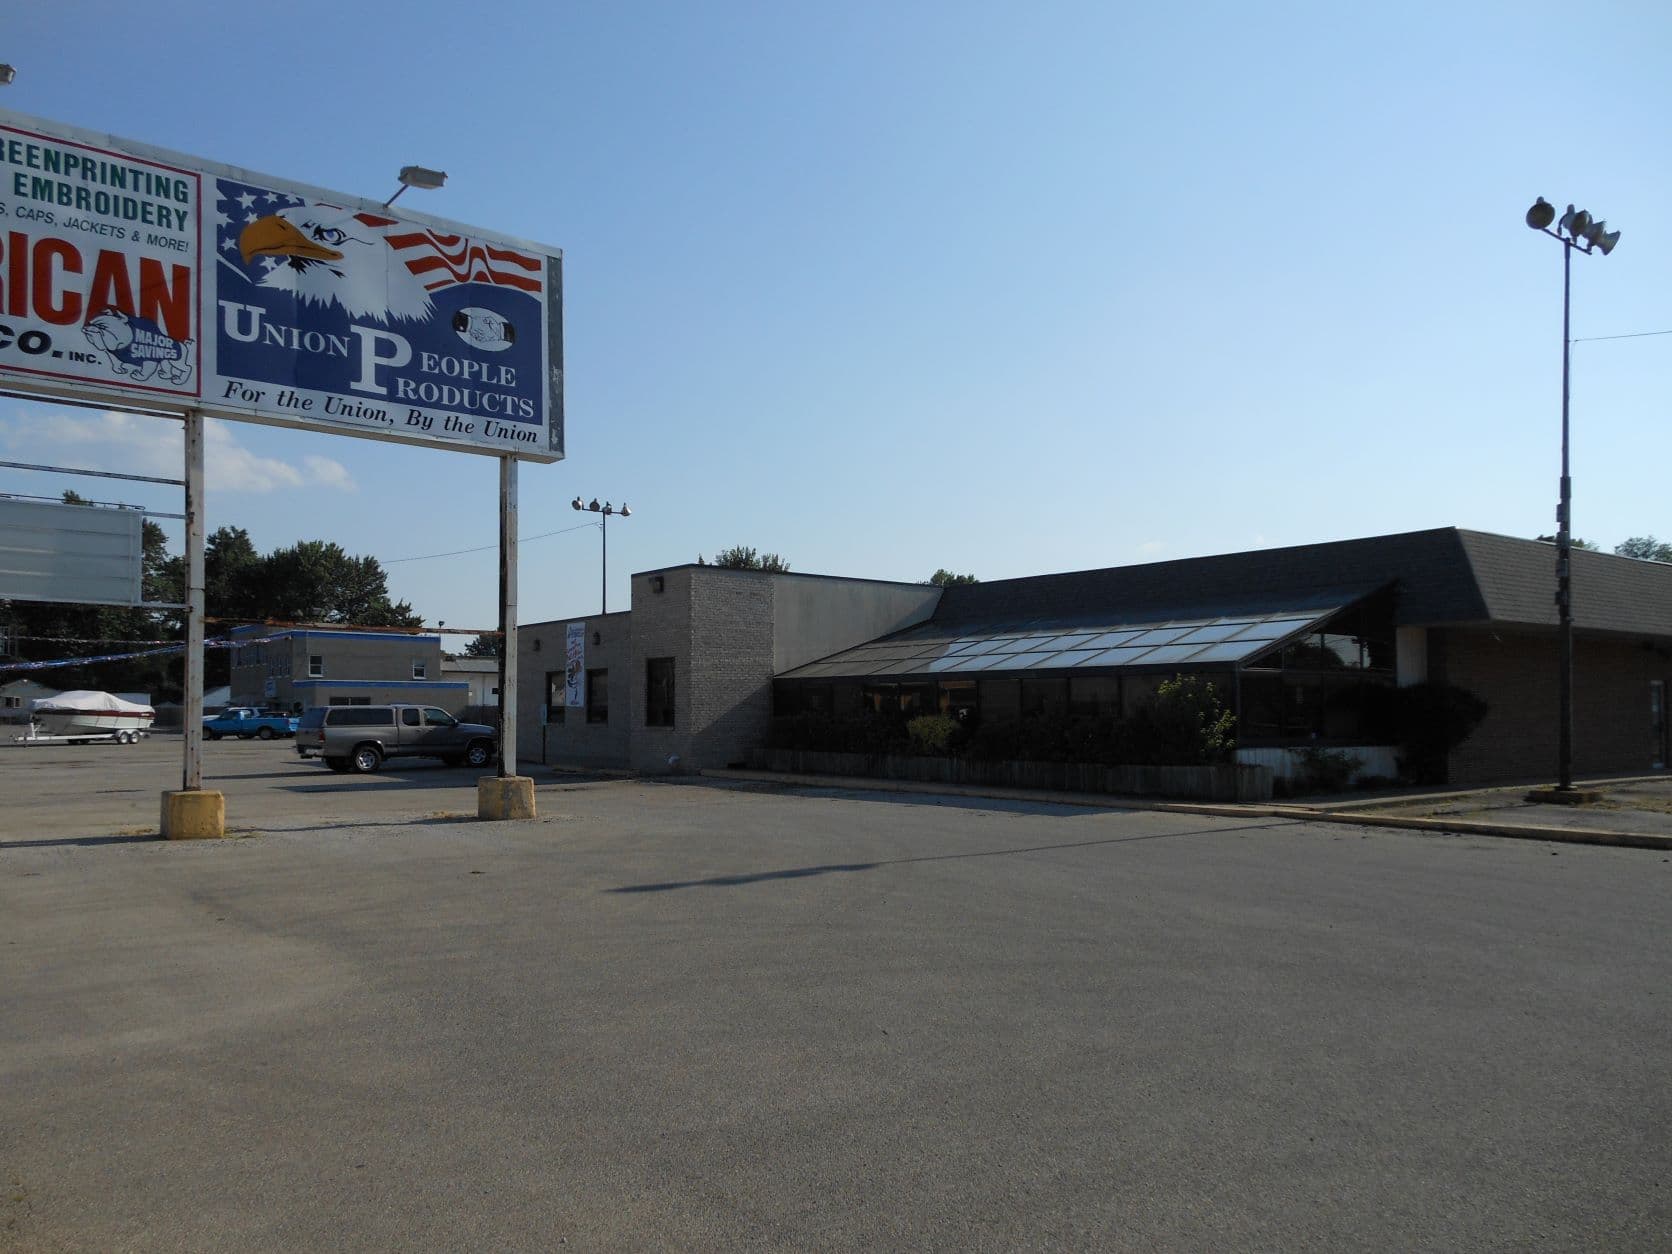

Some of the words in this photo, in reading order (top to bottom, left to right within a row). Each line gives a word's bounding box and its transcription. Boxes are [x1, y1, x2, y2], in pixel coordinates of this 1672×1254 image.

[0, 137, 189, 204] EENPRINTING
[14, 172, 188, 232] EMBROIDERY
[63, 216, 126, 239] JACKETS
[131, 230, 140, 242] &
[147, 233, 189, 252] MORE!
[0, 231, 190, 343] ICAN
[69, 350, 102, 365] INC.
[131, 343, 178, 359] SAVINGS
[134, 328, 174, 349] MAJOR
[221, 380, 265, 403] For
[276, 390, 314, 411] the
[323, 396, 395, 426] Union,
[405, 409, 434, 432] By
[443, 415, 475, 435] the
[484, 420, 538, 443] Union
